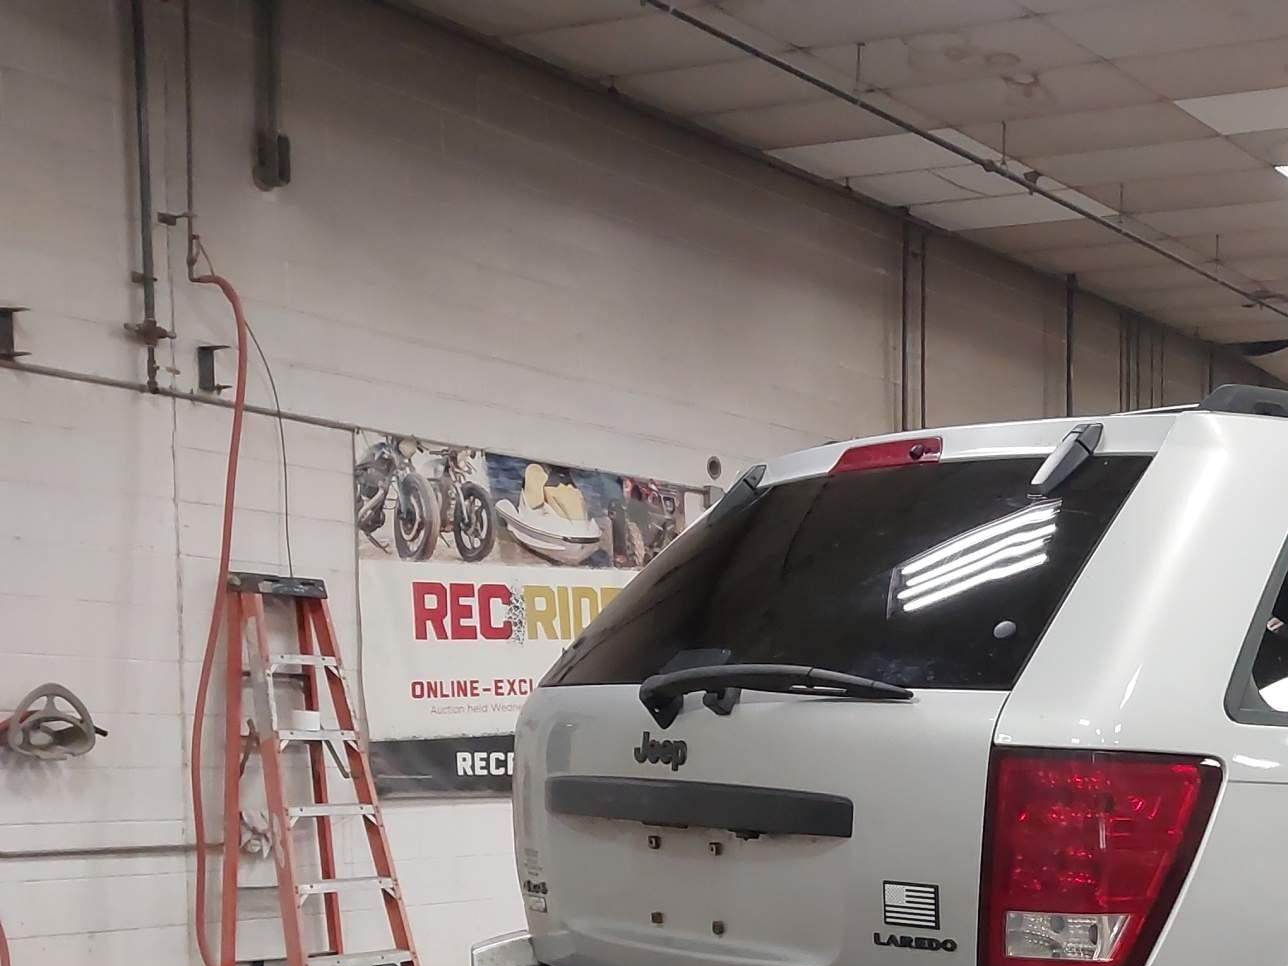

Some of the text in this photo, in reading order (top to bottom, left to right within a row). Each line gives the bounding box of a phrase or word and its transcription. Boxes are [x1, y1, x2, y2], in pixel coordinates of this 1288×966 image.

[411, 581, 626, 641] REC RID
[634, 731, 688, 772] Jeep
[873, 932, 958, 952] LAREDO
